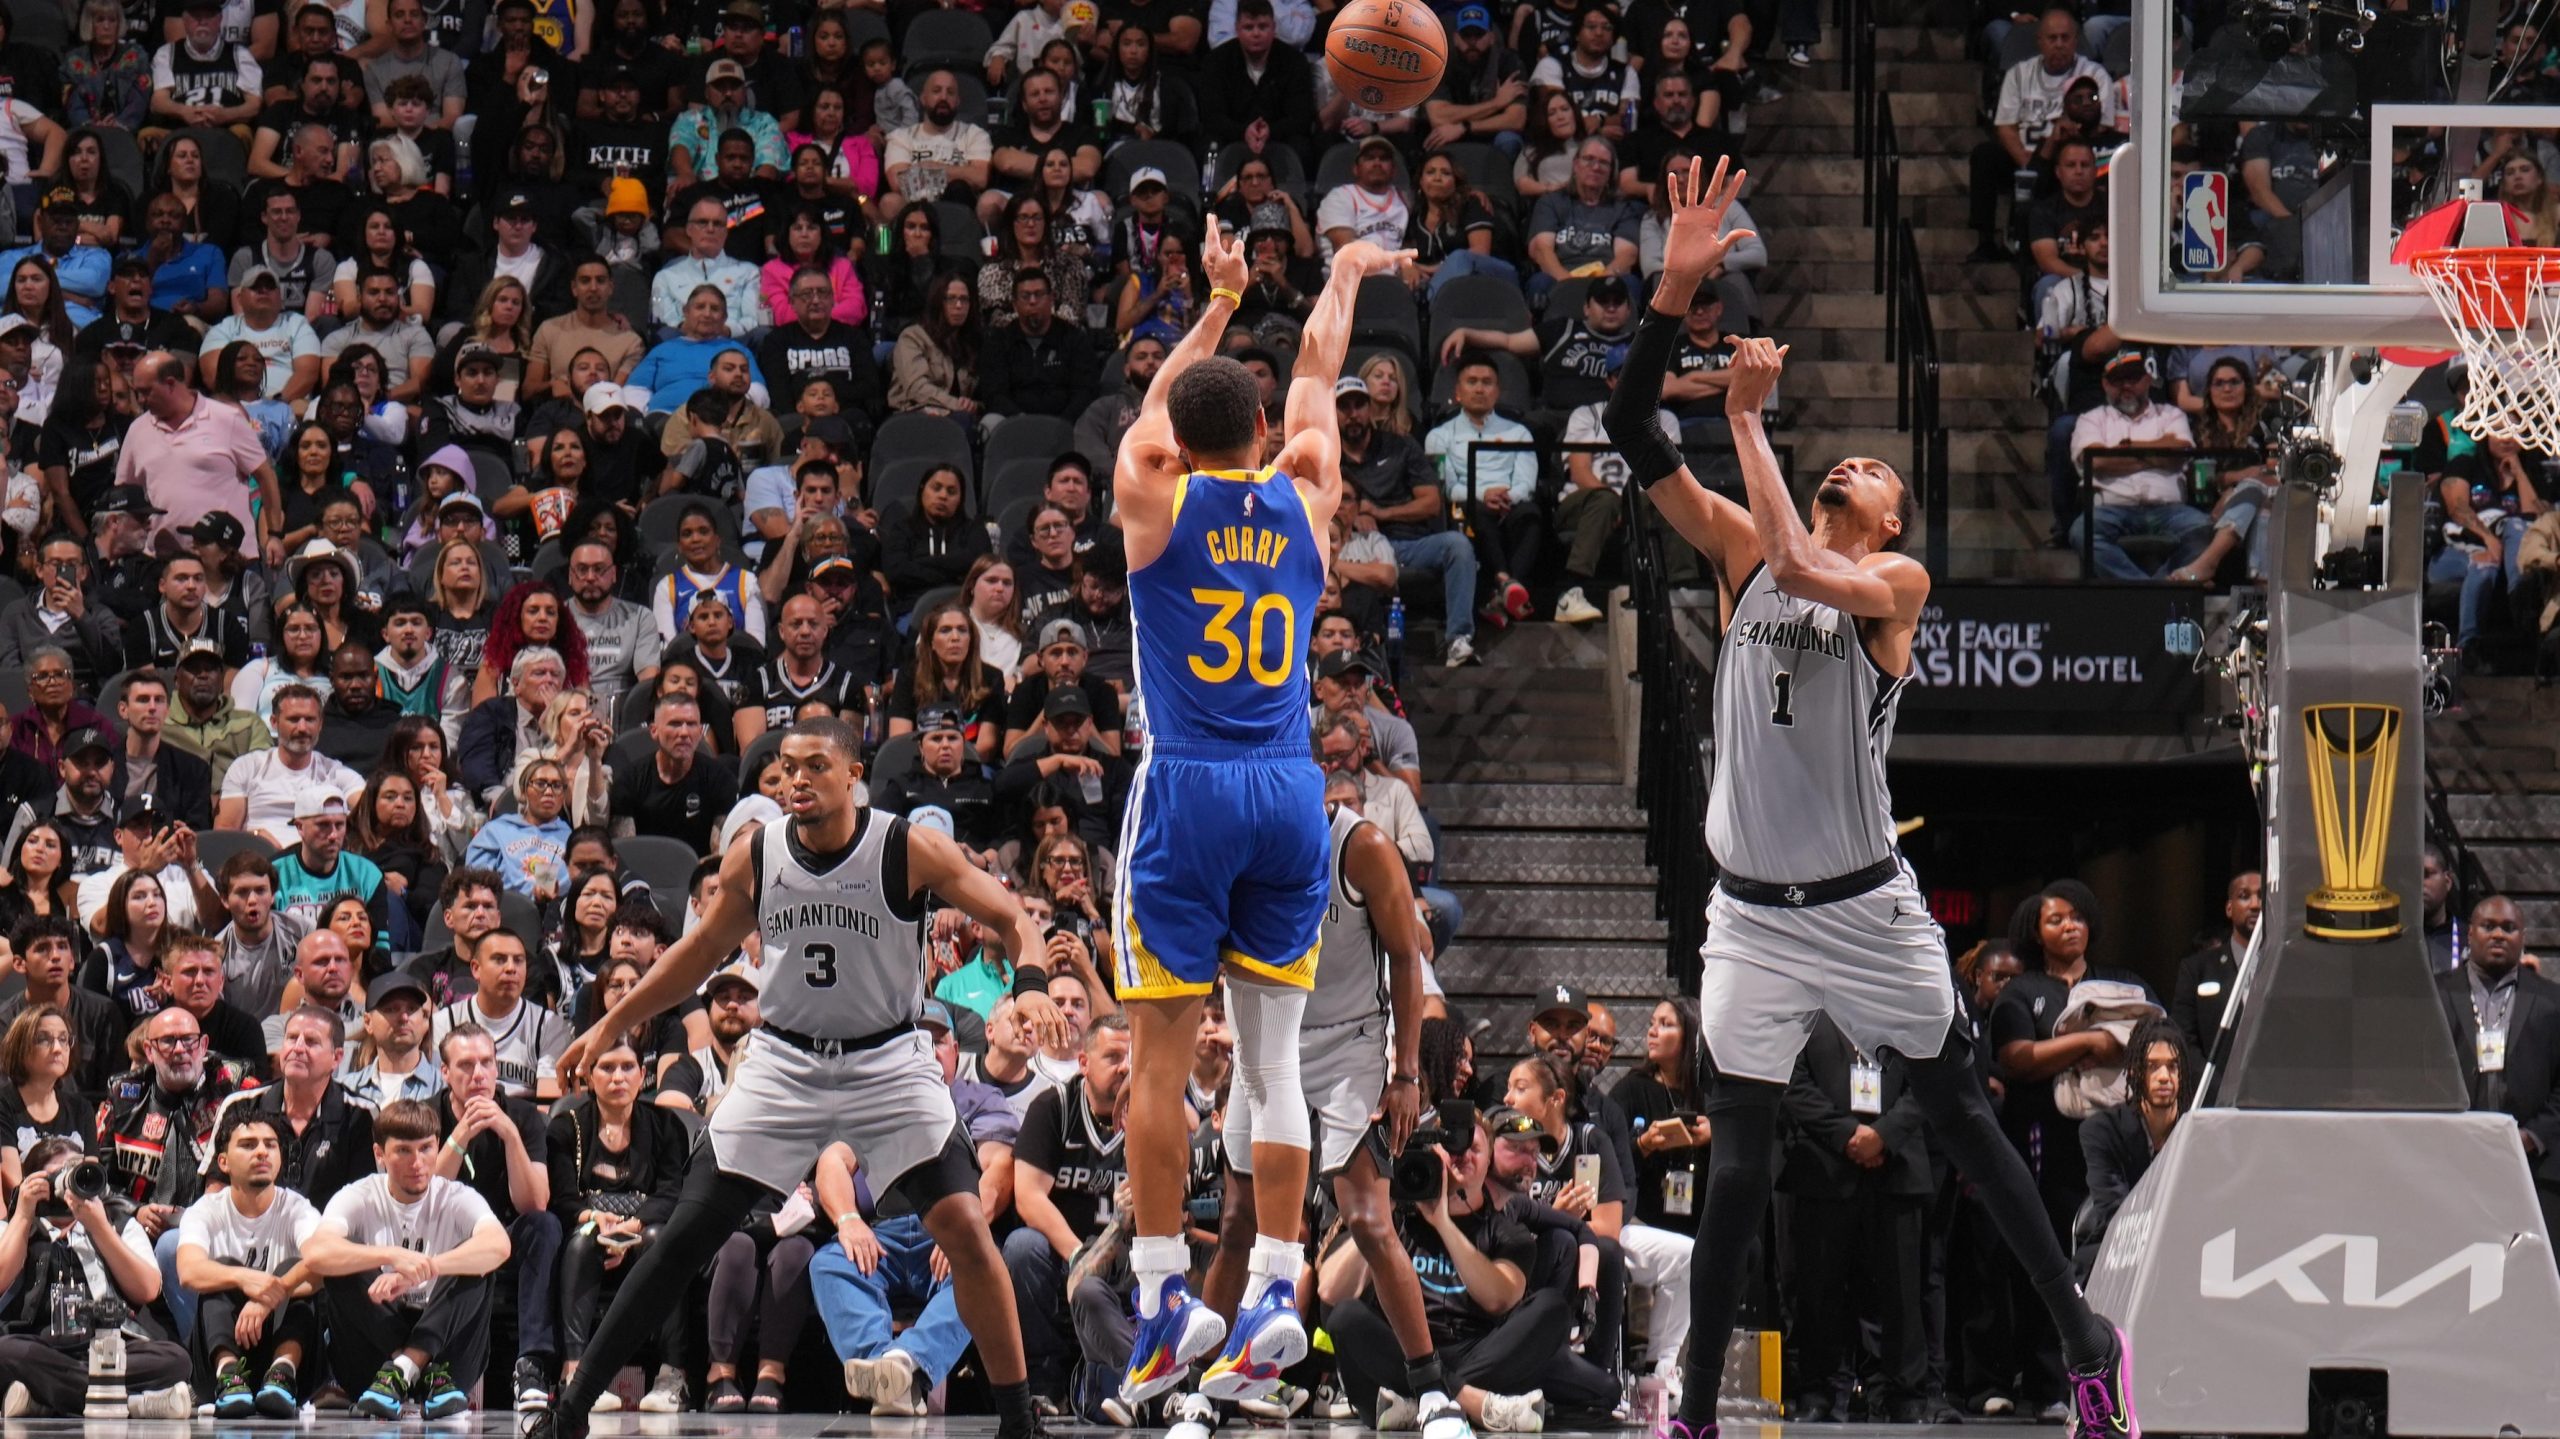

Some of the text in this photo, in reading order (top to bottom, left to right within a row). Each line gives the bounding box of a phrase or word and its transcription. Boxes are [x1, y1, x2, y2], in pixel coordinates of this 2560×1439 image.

[1344, 33, 1421, 73] Wilson
[185, 87, 222, 106] 21
[589, 146, 652, 164] KITH
[2189, 248, 2209, 265] NBA
[787, 347, 852, 370] SPURS
[1206, 526, 1289, 569] CURRY
[1187, 587, 1295, 687] 30
[1959, 620, 2042, 649] EAGLE
[2053, 656, 2143, 682] HOTEL
[1771, 671, 1794, 728] 1
[141, 794, 152, 810] 7
[839, 882, 866, 894] LEDGER
[766, 903, 880, 941] SAN ANTONIO
[803, 943, 837, 989] 3
[1557, 984, 1570, 1003] LA
[2200, 1228, 2506, 1315] KIA
